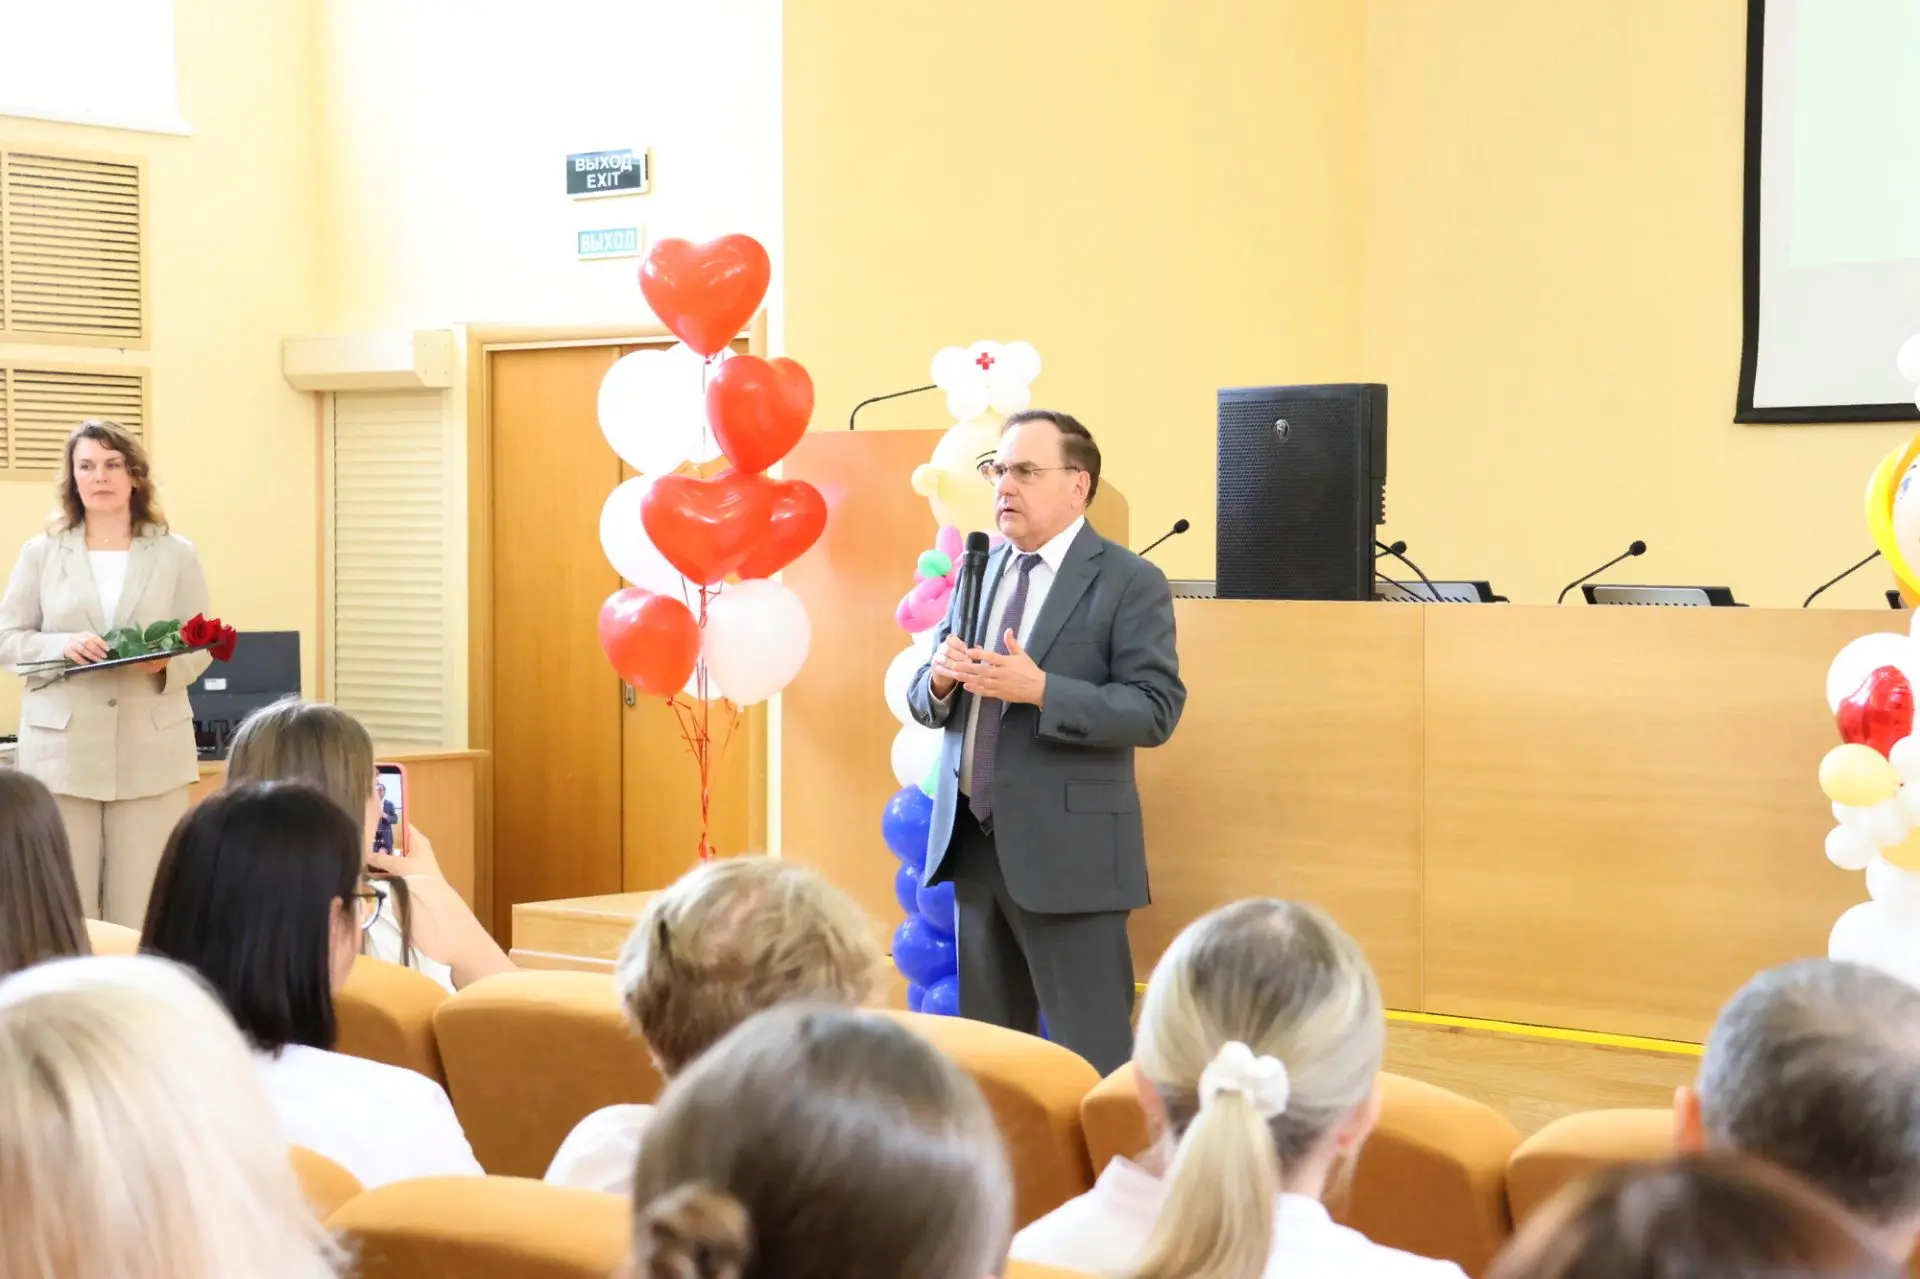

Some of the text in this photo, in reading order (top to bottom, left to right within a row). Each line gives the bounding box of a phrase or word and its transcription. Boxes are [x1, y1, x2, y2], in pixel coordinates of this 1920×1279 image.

[575, 154, 632, 172] ВЫХОД
[587, 172, 620, 189] EXIT
[580, 230, 636, 252] ВЫХОД
